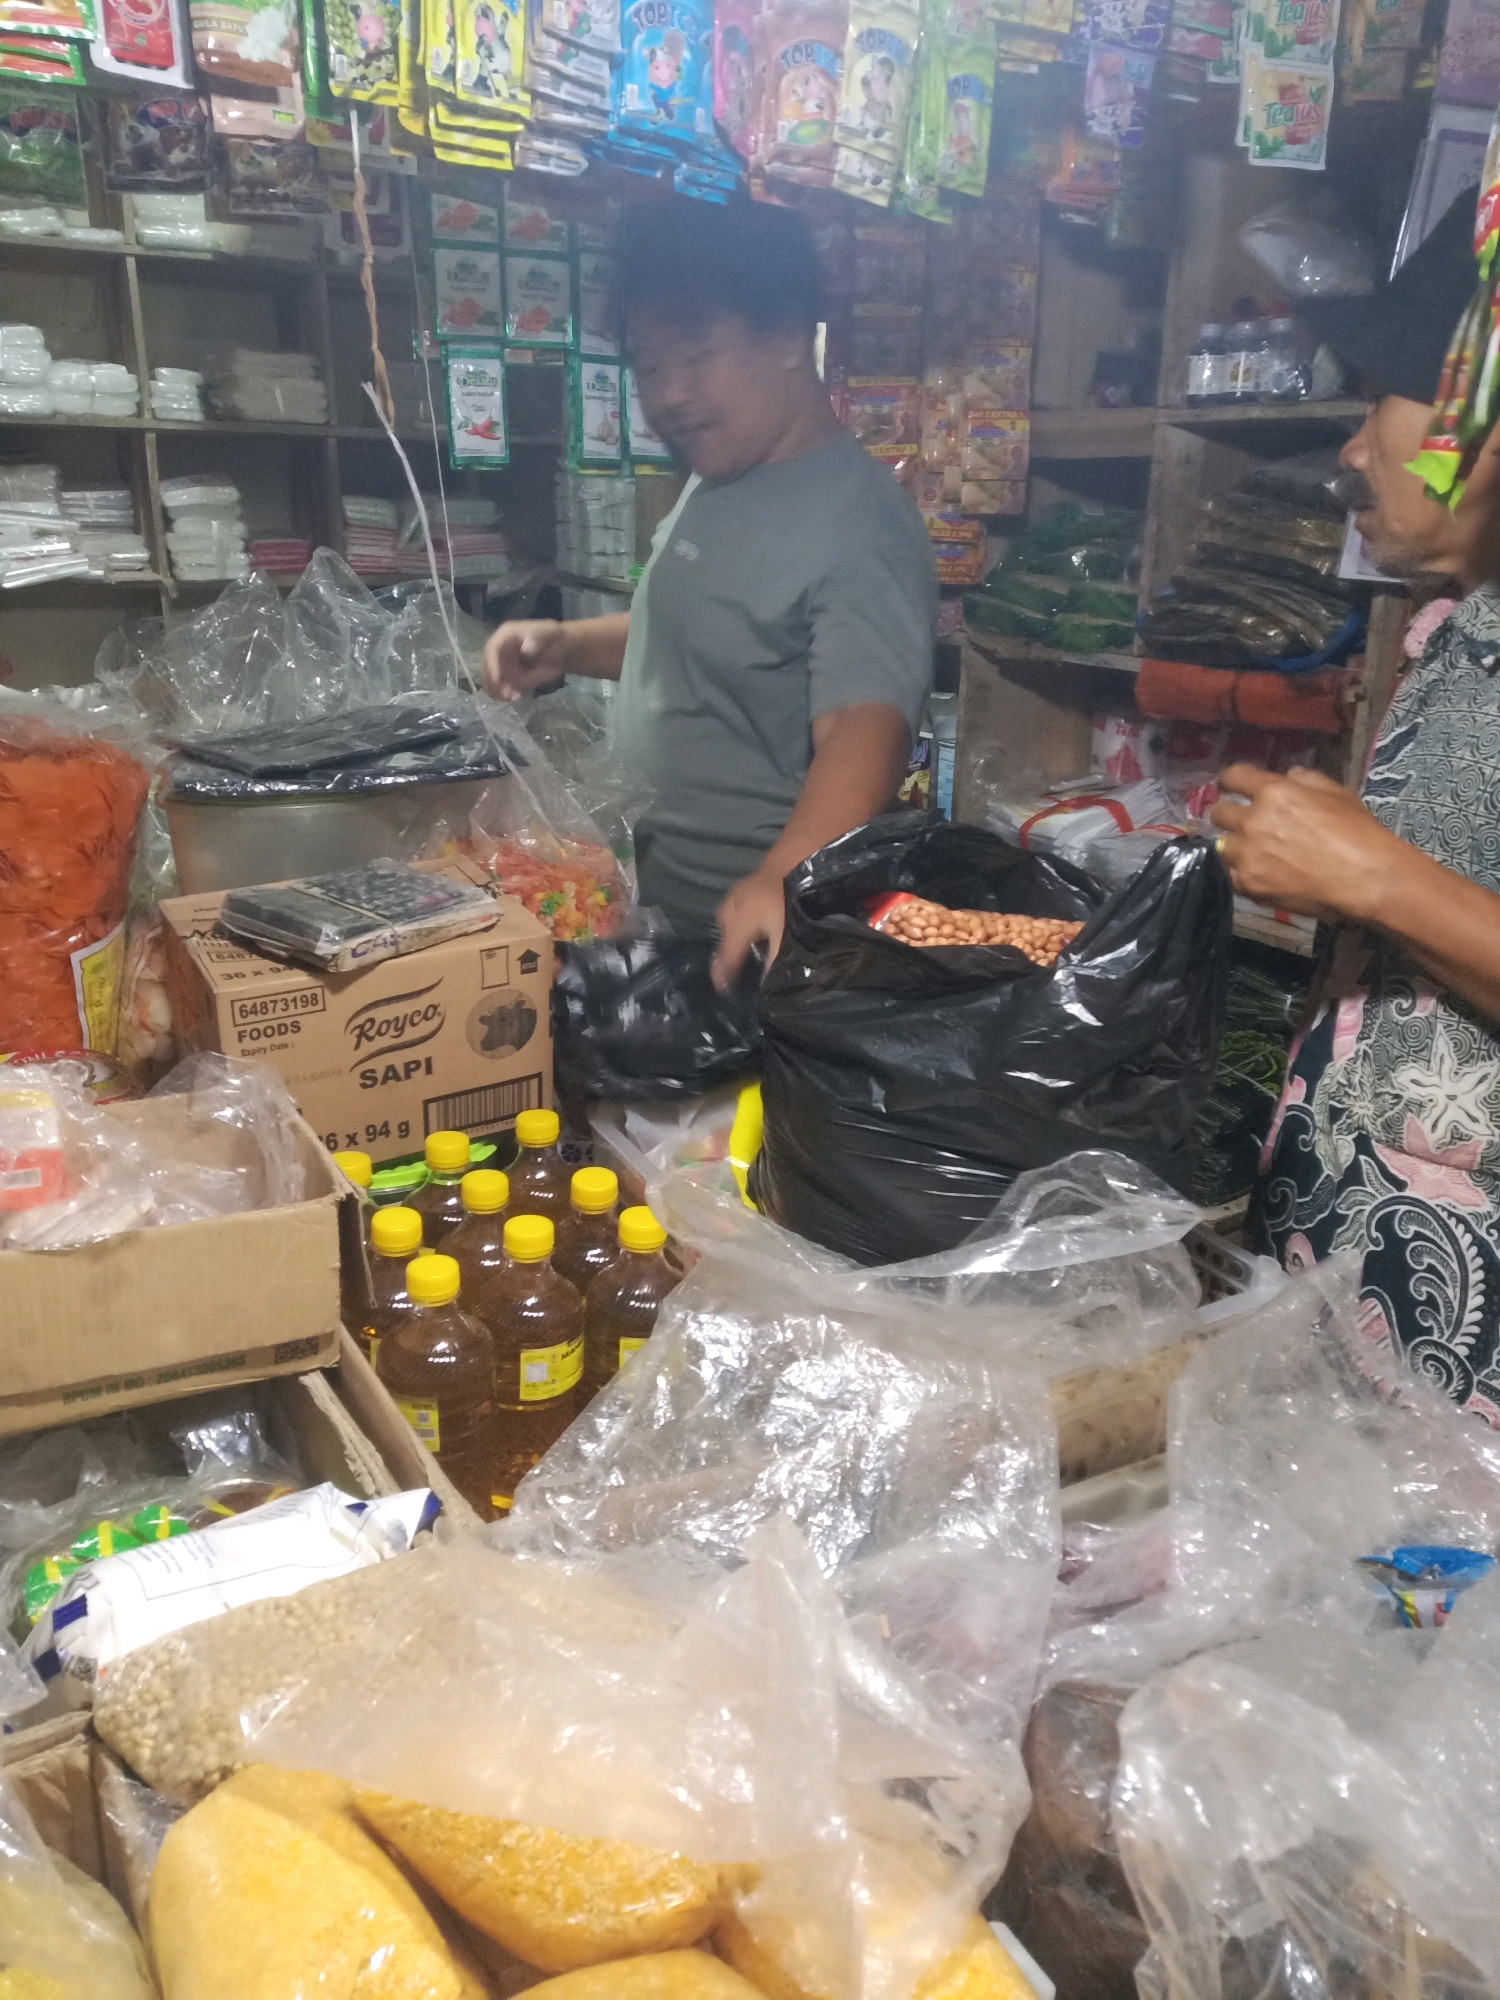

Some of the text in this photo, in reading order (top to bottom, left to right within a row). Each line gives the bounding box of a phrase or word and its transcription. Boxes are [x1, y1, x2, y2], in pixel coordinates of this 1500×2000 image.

[781, 42, 815, 69] TOP
[220, 971, 247, 981] 36
[239, 992, 319, 1019] 64873198
[237, 1020, 301, 1044] FOODS
[350, 1002, 443, 1051] Royco
[241, 1046, 268, 1057] Expiry
[269, 1042, 289, 1052] Date
[359, 1056, 433, 1089] SAPI
[345, 1130, 360, 1148] x
[365, 1120, 391, 1143] 94
[397, 1120, 410, 1139] g
